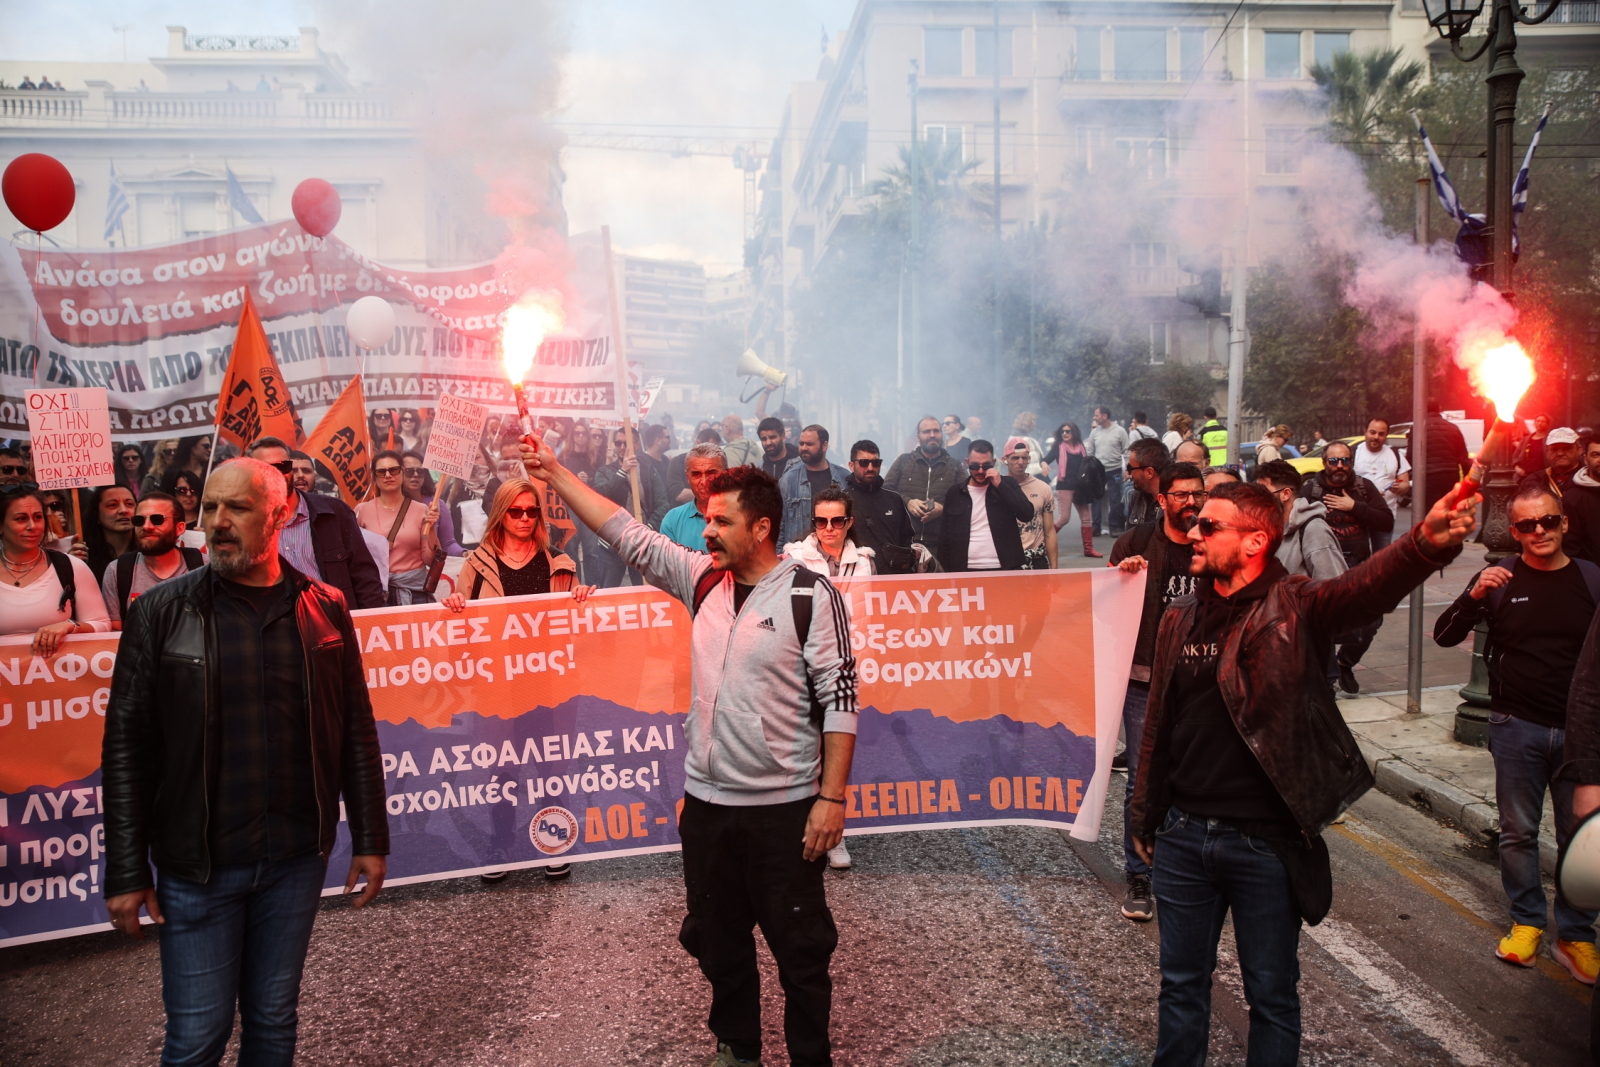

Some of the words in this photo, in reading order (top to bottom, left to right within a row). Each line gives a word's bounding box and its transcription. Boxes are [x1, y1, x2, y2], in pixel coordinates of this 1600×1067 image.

[35, 259, 144, 287] Ανάσα
[152, 252, 226, 283] στον
[235, 228, 327, 267] αγώνα
[60, 290, 195, 327] δουλειά
[202, 286, 248, 315] και
[258, 264, 318, 304] ζωή
[319, 273, 347, 298] με
[46, 350, 77, 388] ΤΑ
[70, 359, 147, 393] ΧΕΡΙΑ
[150, 350, 203, 389] ΑΠΟ
[206, 345, 234, 376] ΤΟ
[260, 375, 280, 410] ΔΟΕ
[441, 395, 462, 411] ΟΧΙ
[463, 402, 483, 418] ΣΤΗΝ
[38, 410, 89, 431] ΣΤΗΝ
[32, 432, 104, 451] ΚΑΤΗΓΟΡΙΟ
[40, 448, 91, 465] ΠΟΙΗΣΗ
[864, 586, 985, 616] ΠΑΥΣΗ
[501, 601, 674, 641] ΑΥΞΗΣΕΙΣ
[756, 623, 777, 633] adidas
[964, 624, 1015, 646] και
[503, 643, 577, 681] μας!
[860, 651, 1032, 687] θαρχικών!
[429, 730, 615, 776] ΑΣΦΑΛΕΙΑΣ
[622, 724, 675, 754] ΚΑΙ
[21, 785, 104, 826] ΛΥΣ
[385, 776, 517, 816] σχολικές
[526, 760, 661, 805] μονάδες!
[843, 778, 961, 819] ΣΕΕΠΕΑ
[989, 775, 1083, 814] ΟΙΕΛΕ
[539, 819, 568, 841] ΔΟΕ
[584, 801, 649, 844] ΔΟΕ
